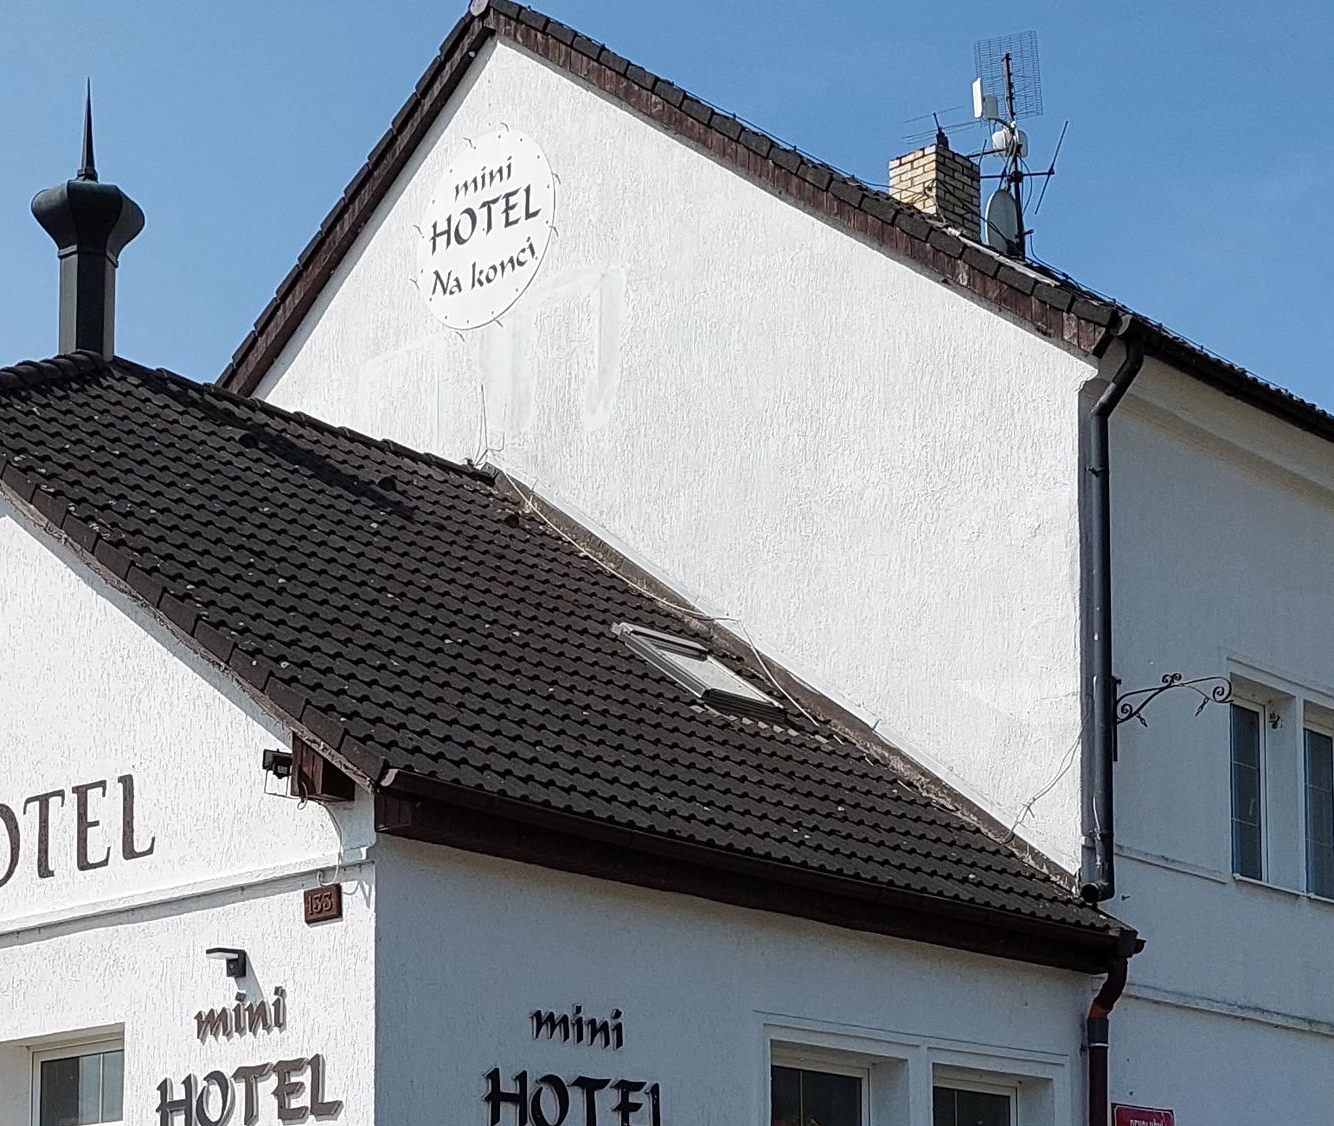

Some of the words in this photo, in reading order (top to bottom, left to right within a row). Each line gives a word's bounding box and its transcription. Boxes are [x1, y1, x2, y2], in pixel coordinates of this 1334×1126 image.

[454, 155, 512, 202] mini
[429, 183, 542, 256] HOTEL
[431, 269, 463, 297] Na
[471, 236, 536, 290] konci
[308, 891, 333, 915] 133
[193, 985, 288, 1046] mini
[529, 1003, 624, 1050] mini
